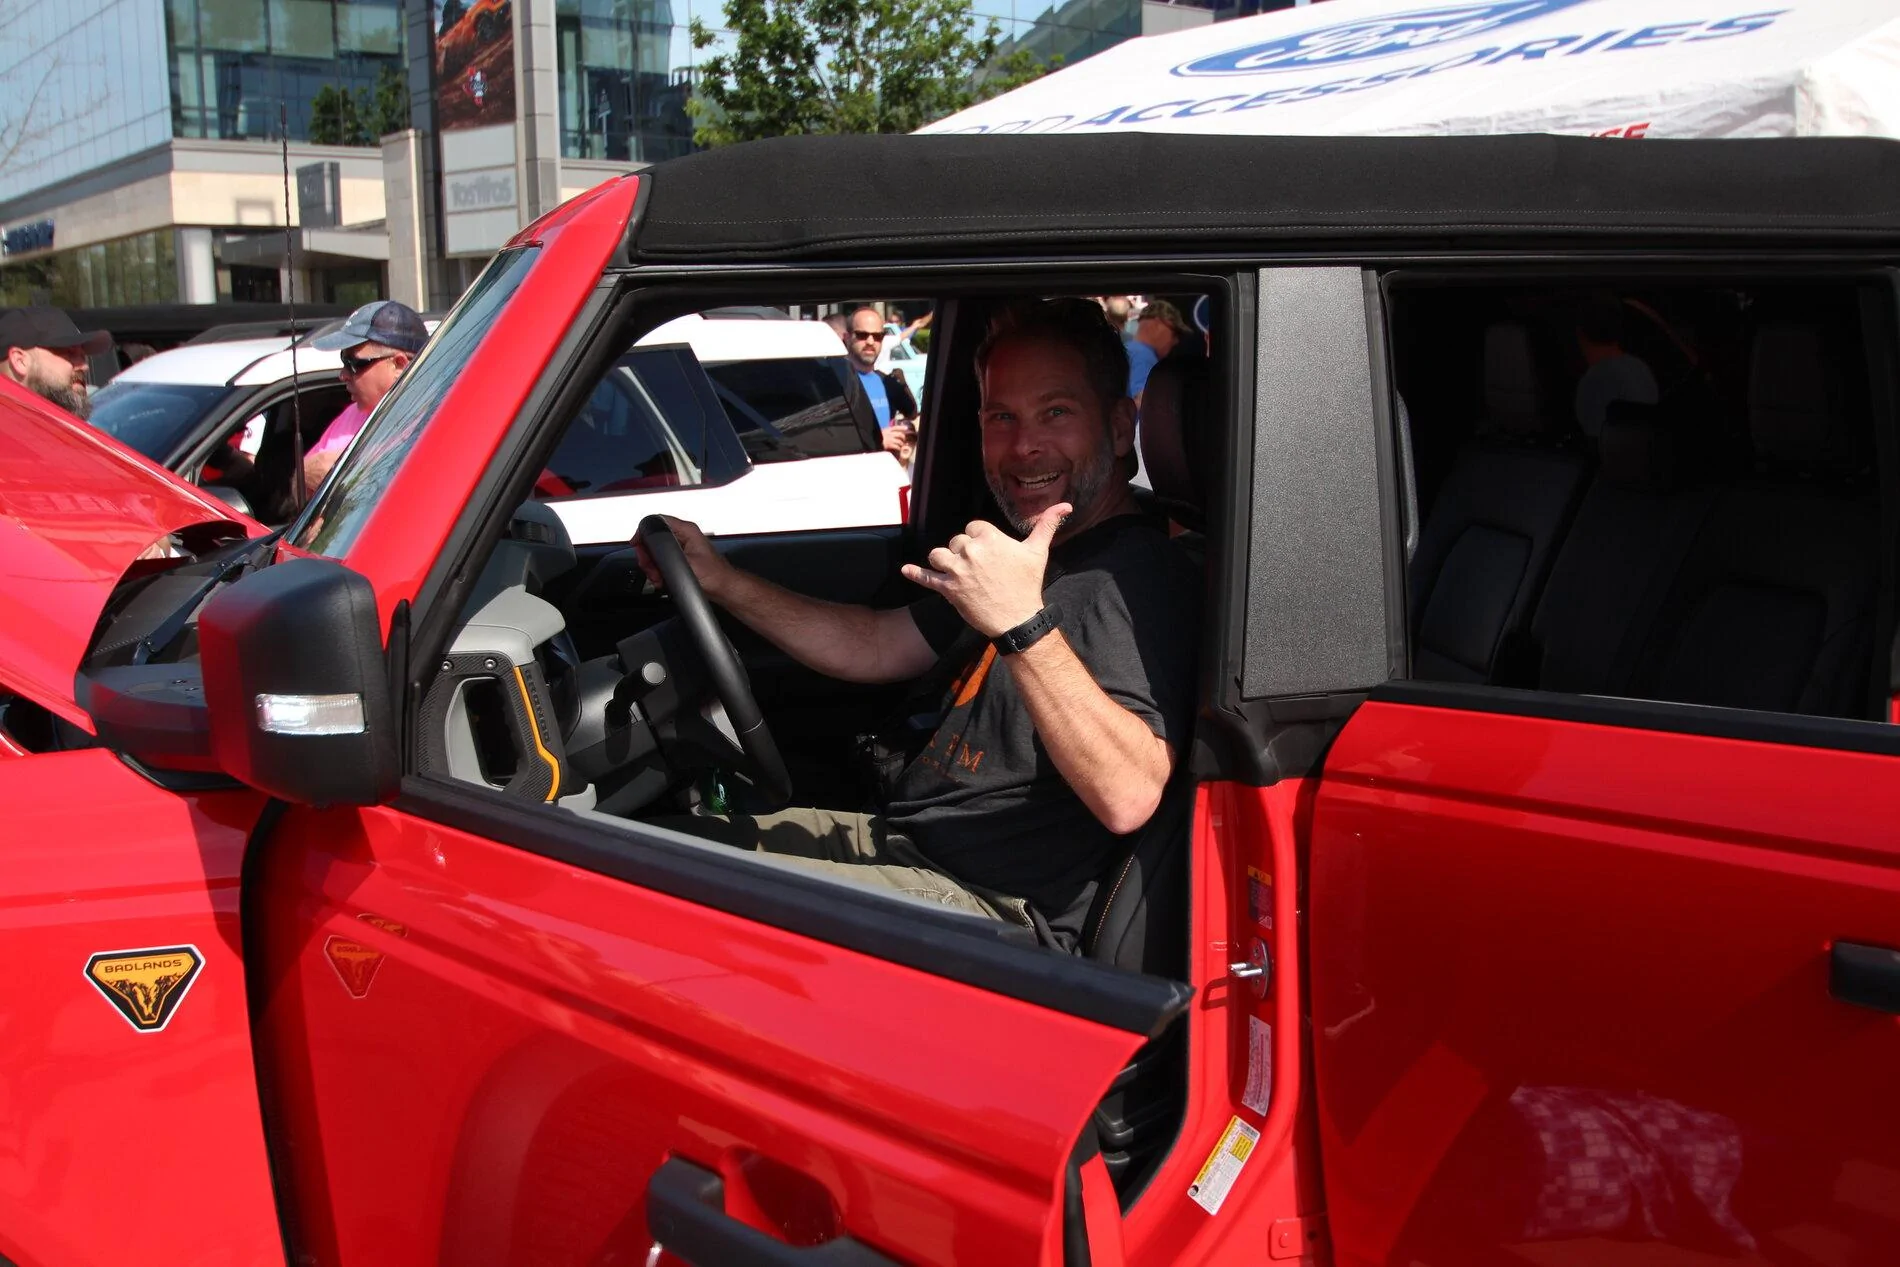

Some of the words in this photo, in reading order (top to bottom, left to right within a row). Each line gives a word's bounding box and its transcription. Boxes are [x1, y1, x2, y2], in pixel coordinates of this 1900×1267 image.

[1235, 1, 1548, 69] Ford
[1060, 8, 1796, 134] ACCESSORIES
[105, 959, 182, 974] BADLANDS
